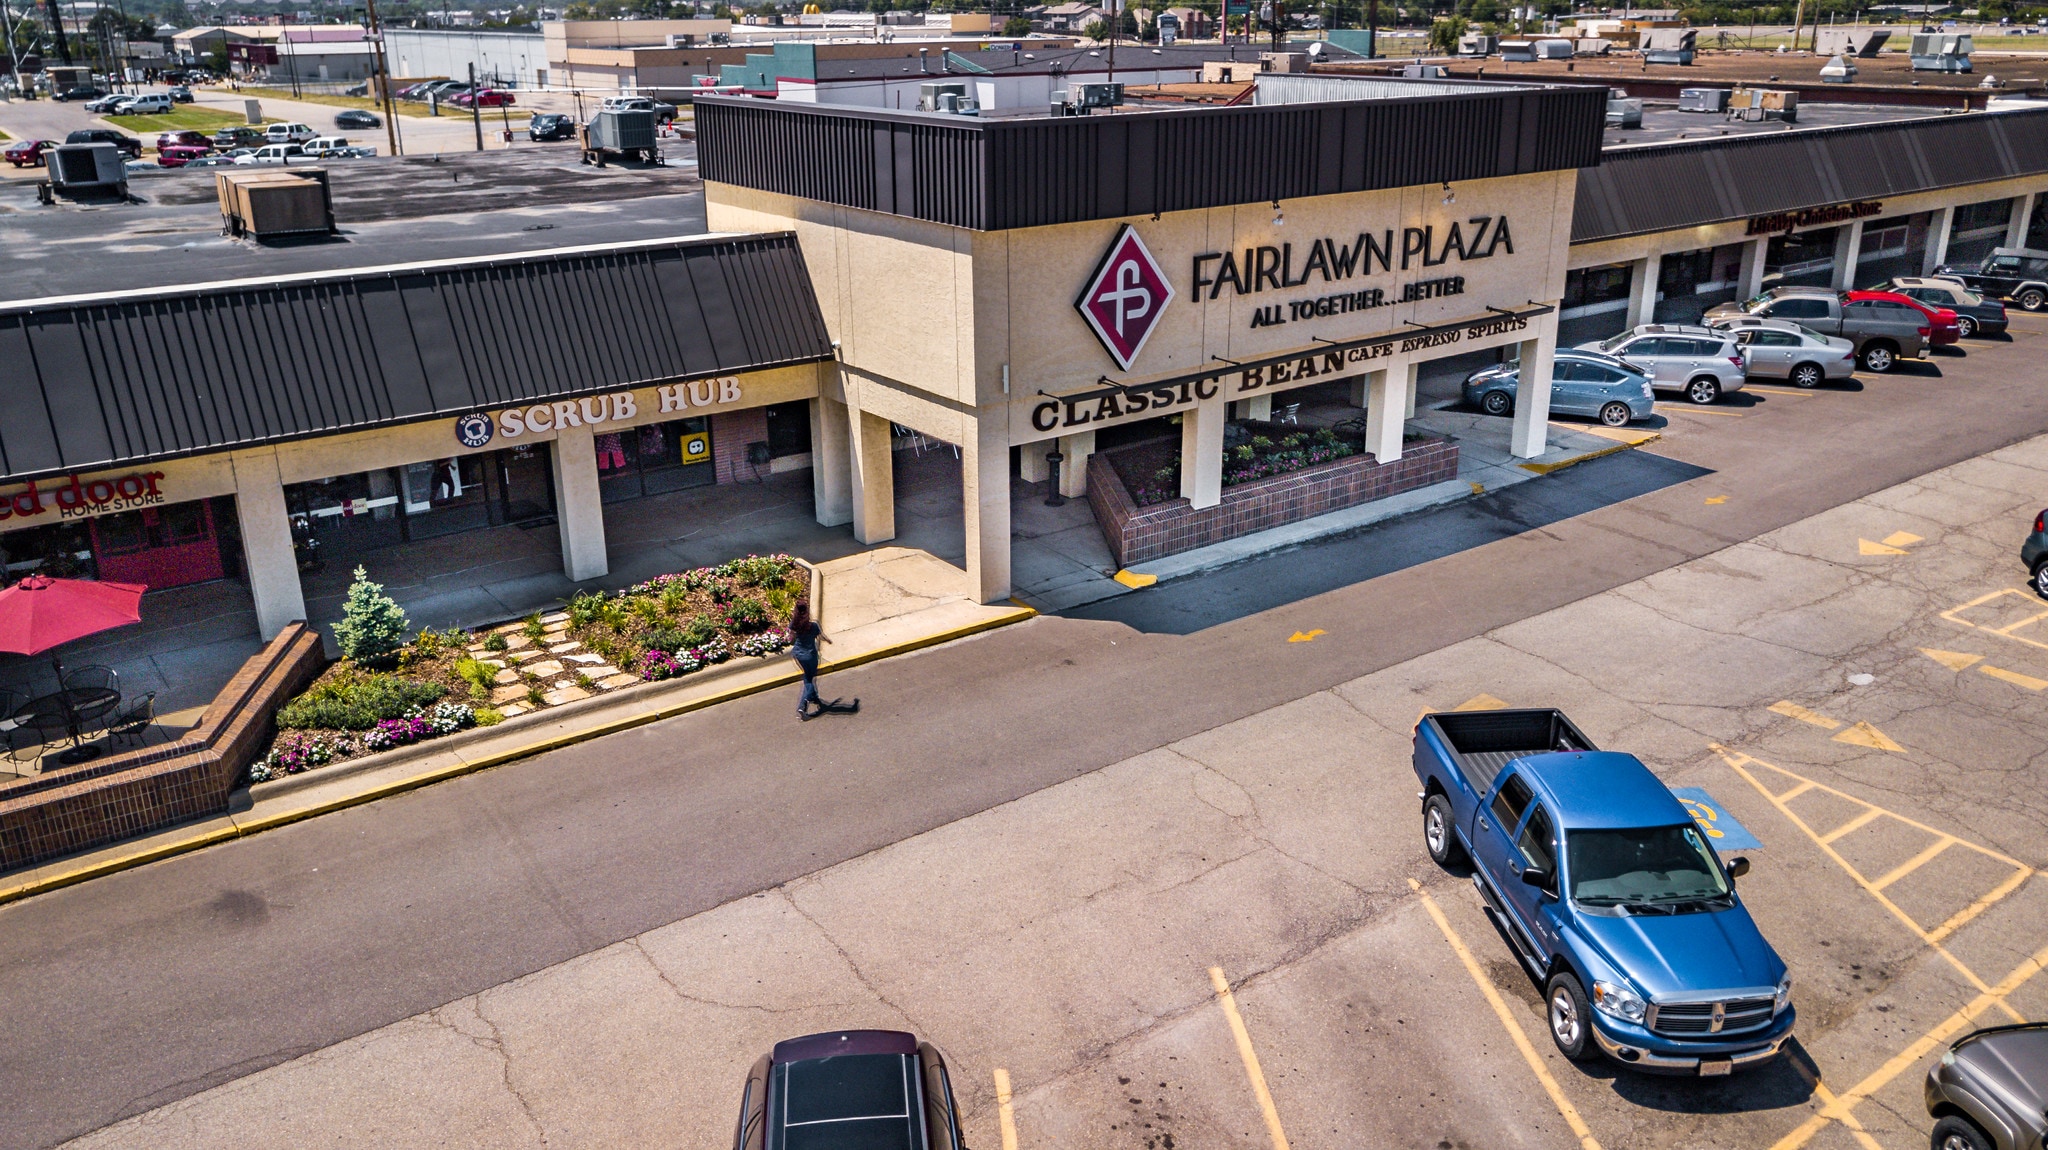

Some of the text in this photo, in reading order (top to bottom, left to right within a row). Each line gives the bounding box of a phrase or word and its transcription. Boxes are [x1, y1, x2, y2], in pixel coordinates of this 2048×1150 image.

[1192, 215, 1514, 302] FAIRLAWN PLAZA
[1250, 304, 1287, 328] ALL
[1347, 318, 1528, 363] CAFE ESPRESSO SPIRITS
[499, 376, 742, 438] SCRUB HUB
[1031, 349, 1345, 431] CLASSIC BEAN
[460, 412, 489, 426] SCRUB
[463, 434, 490, 446] HUB
[0, 473, 165, 521] ed door
[60, 493, 165, 518] HOME STORE
